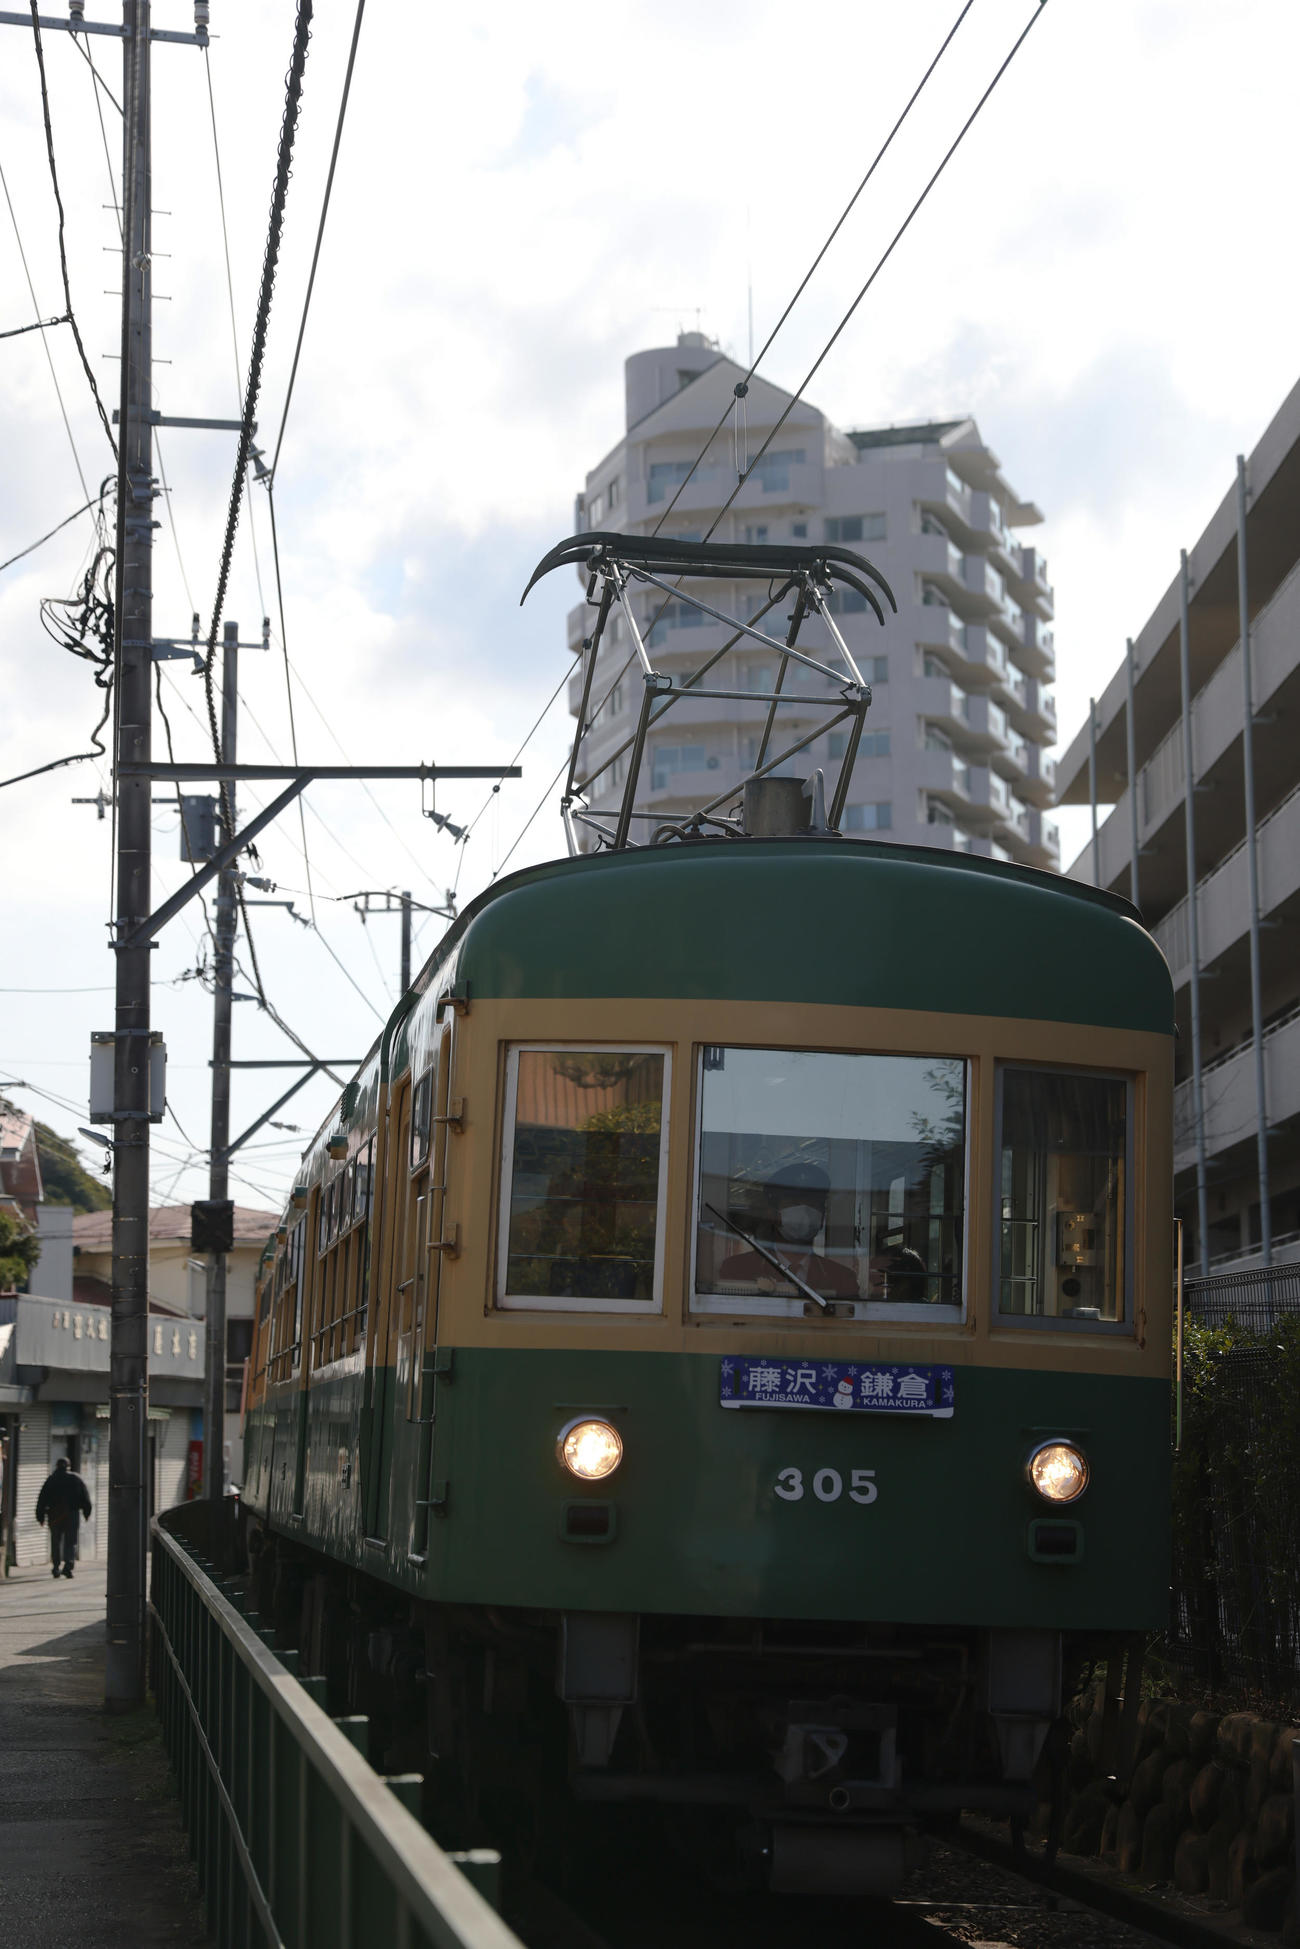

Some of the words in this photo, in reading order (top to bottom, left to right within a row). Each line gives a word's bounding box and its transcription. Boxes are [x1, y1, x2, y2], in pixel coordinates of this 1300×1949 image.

[748, 1367, 816, 1393] 藤沢
[860, 1371, 929, 1399] 鎌倉
[755, 1392, 811, 1403] FUJISAWA
[863, 1397, 926, 1408] KAMAKURA
[774, 1467, 878, 1504] 305
